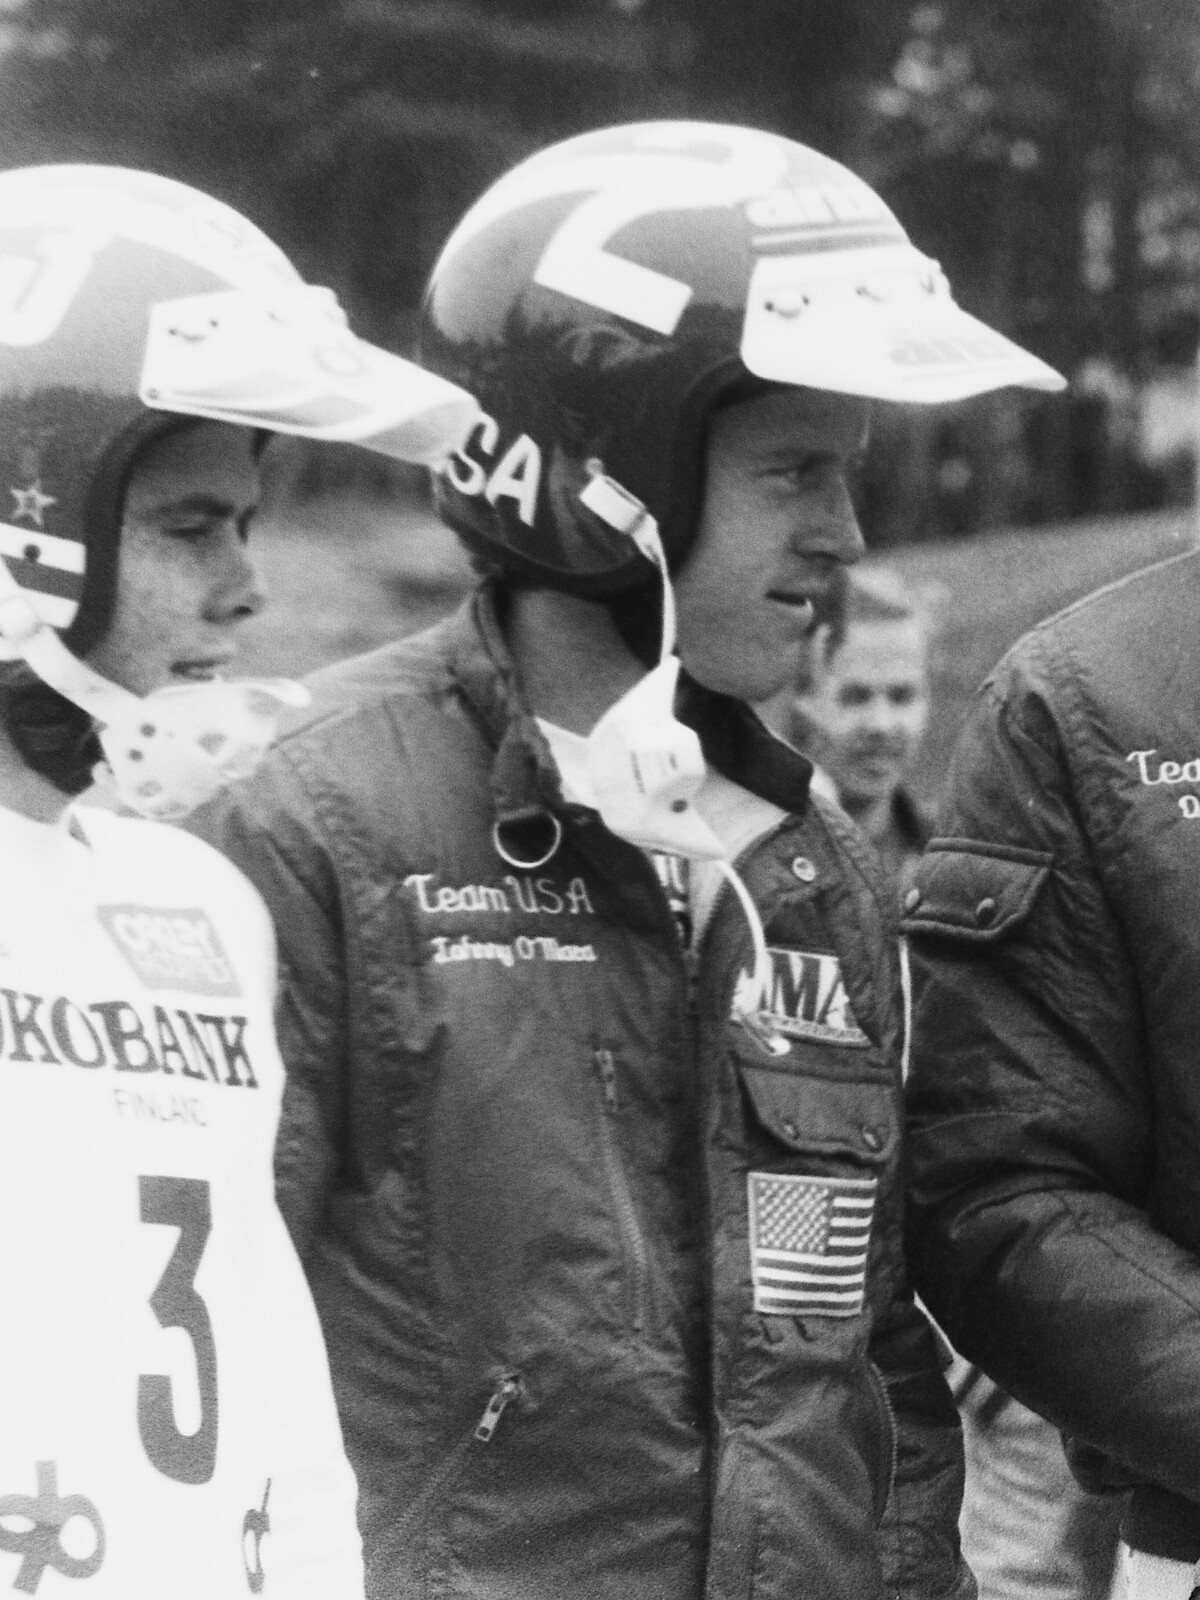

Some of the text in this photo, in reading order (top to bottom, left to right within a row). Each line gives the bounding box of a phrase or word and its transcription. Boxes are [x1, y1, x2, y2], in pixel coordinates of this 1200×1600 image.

[446, 412, 542, 527] SA
[403, 873, 595, 915] Team USA
[0, 987, 260, 1090] KOBANK
[137, 1175, 218, 1485] 3
